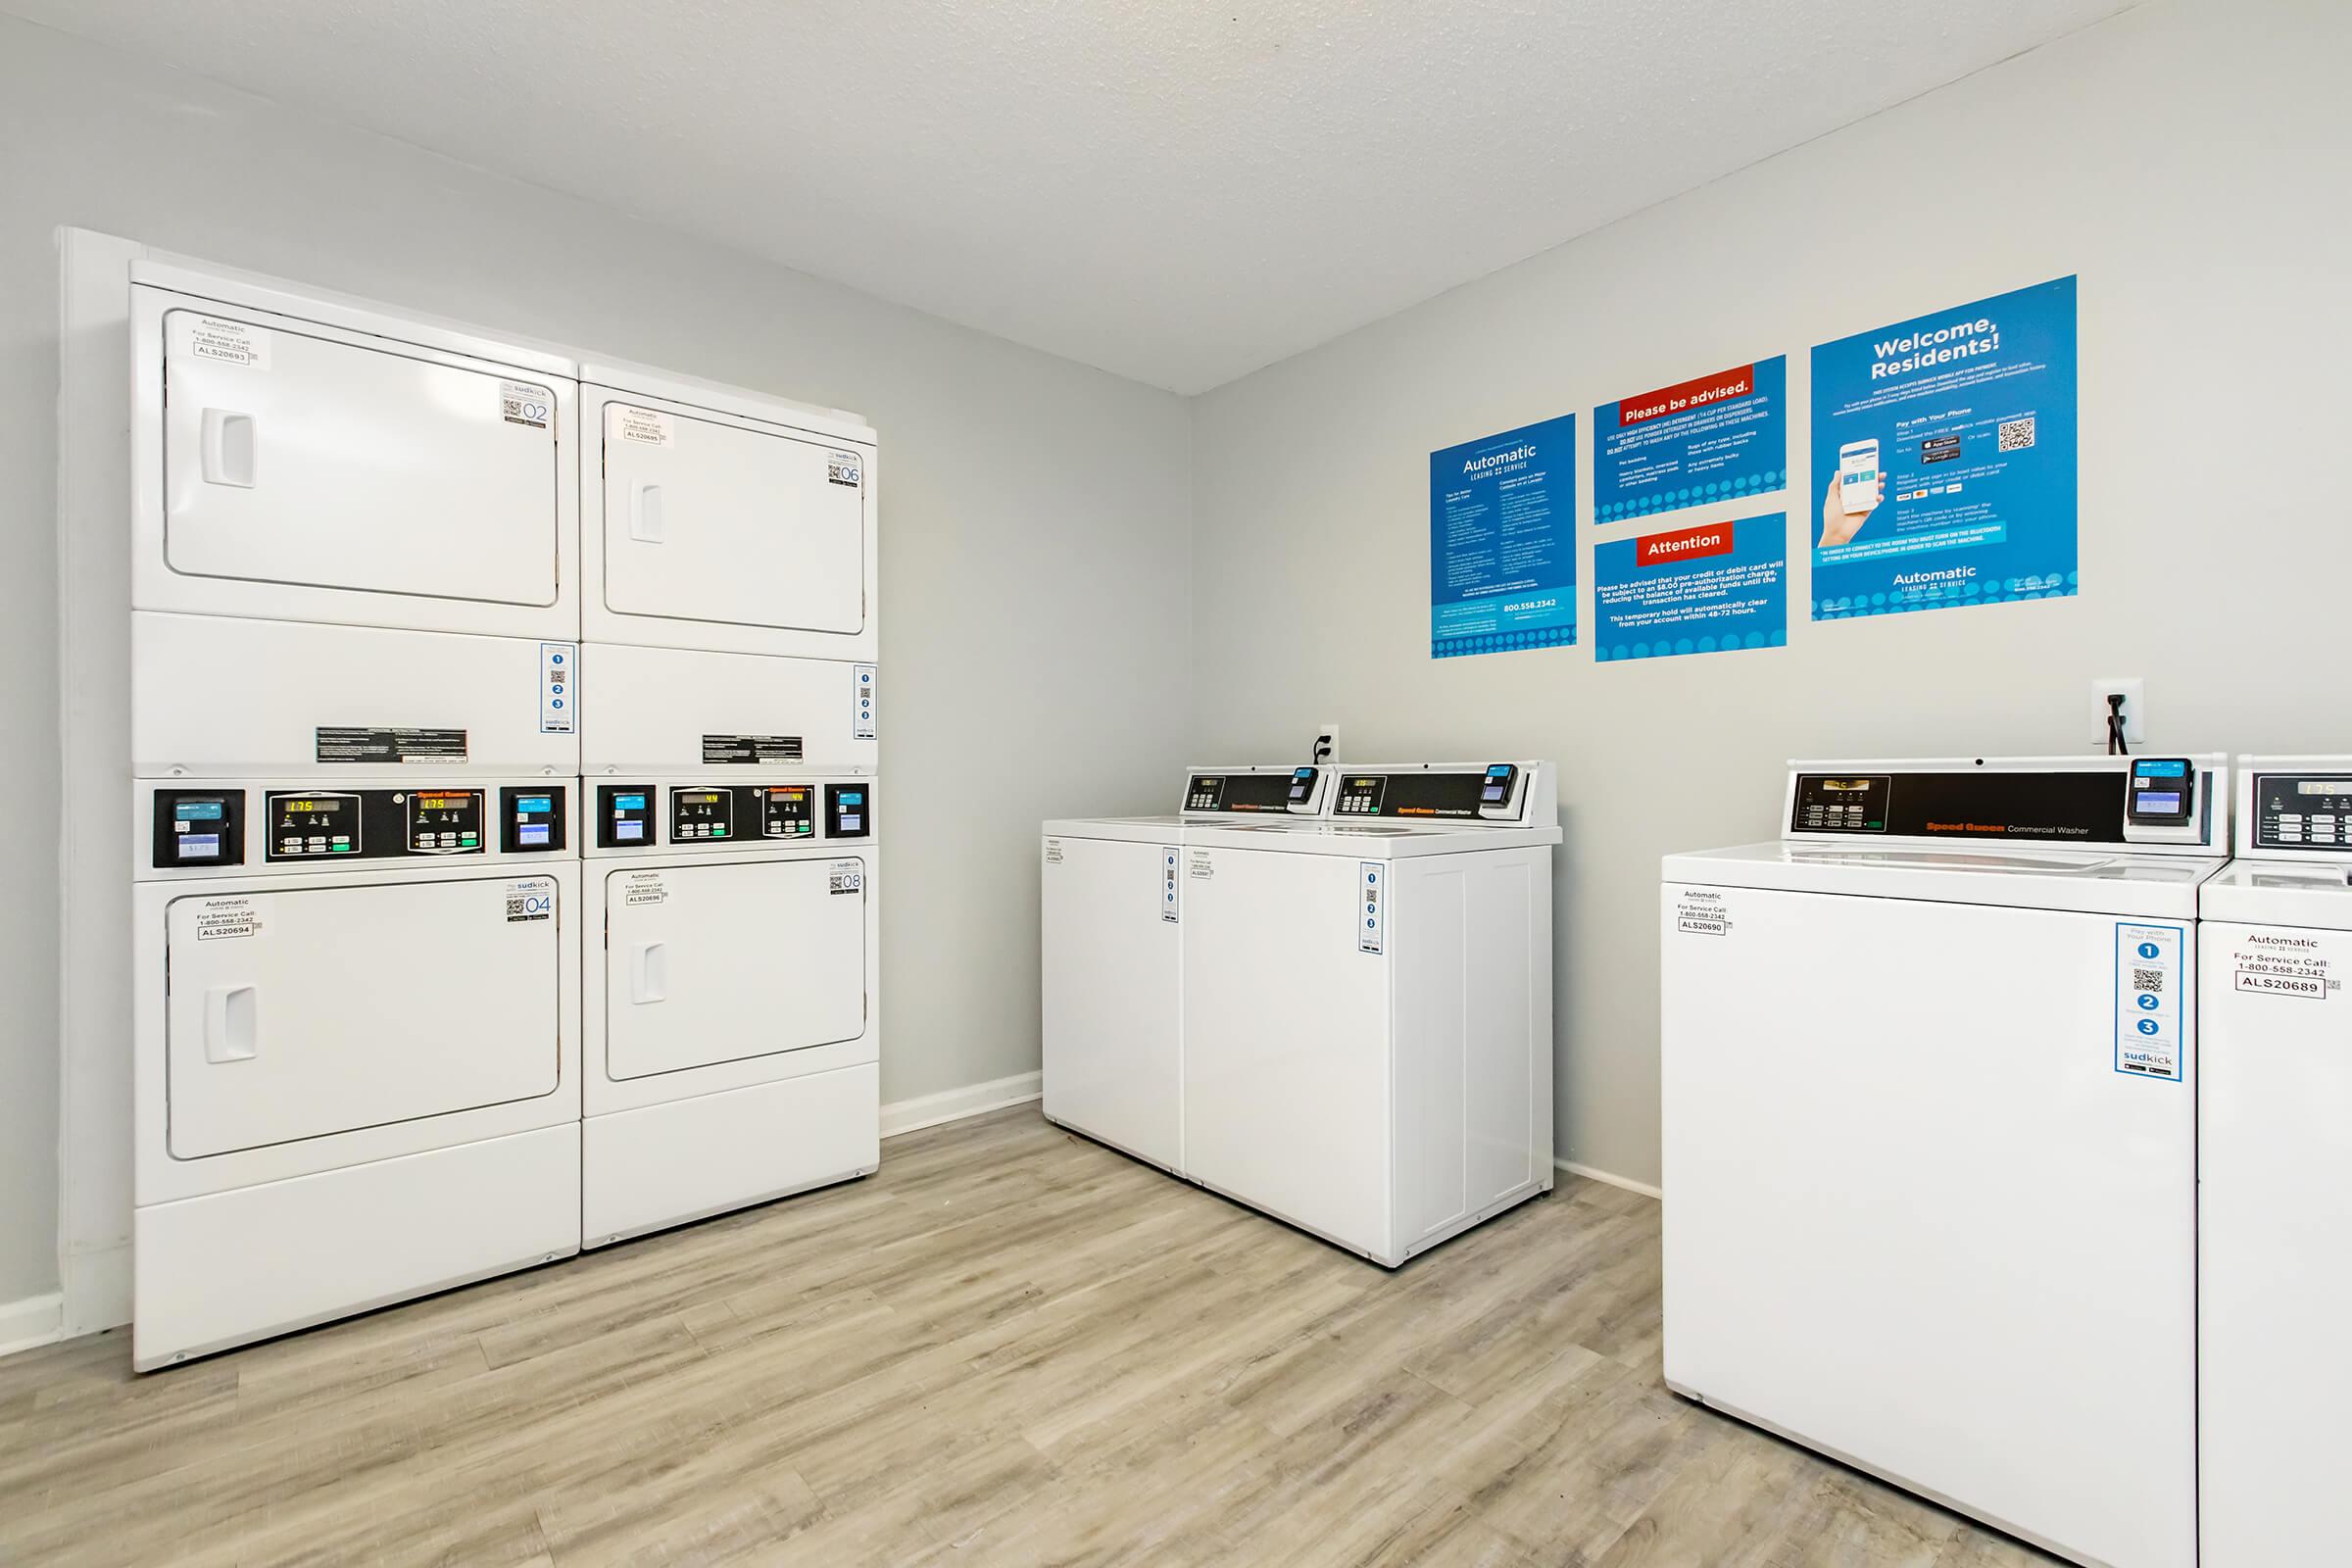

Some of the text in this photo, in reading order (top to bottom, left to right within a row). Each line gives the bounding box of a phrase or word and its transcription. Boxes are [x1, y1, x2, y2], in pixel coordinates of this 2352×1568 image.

[202, 319, 245, 333] Automatic
[208, 331, 234, 341] Service
[1875, 319, 1995, 358] Welcome,
[198, 347, 245, 361] ALS20693
[1872, 333, 1998, 378] Residents!
[1626, 380, 1747, 421] Please be advised.
[523, 403, 547, 421] 02
[1947, 408, 1971, 416] Phone
[1463, 446, 1535, 472] Automatic
[841, 466, 859, 482] 06
[1470, 469, 1493, 480] LEASING
[1503, 461, 1526, 472] SERVICE
[1648, 535, 1720, 555] Attention
[1680, 574, 1744, 587] pre-authorization
[1893, 566, 1975, 584] Automatic
[1630, 578, 1656, 588] advised
[1674, 586, 1683, 595] of
[1685, 584, 1717, 593] available
[1762, 574, 1776, 583] the
[1642, 596, 1682, 605] transaction
[1697, 589, 1728, 598] cleared.
[1504, 599, 1555, 612] 800.558.2342
[1694, 601, 1745, 612] automatically
[1927, 821, 2089, 835] Speed Queen Commercial Washer
[843, 874, 860, 888] 08
[1684, 891, 1722, 900] Automatic
[525, 896, 551, 912] 04
[202, 927, 249, 937] ALS20694
[1682, 921, 1722, 931] ALS20690
[2248, 935, 2319, 948] Automatic
[2256, 955, 2300, 965] Service
[2238, 962, 2326, 977] 1-800-558-2342
[2242, 976, 2319, 992] ALS20689
[2125, 1052, 2173, 1065] sudkick
